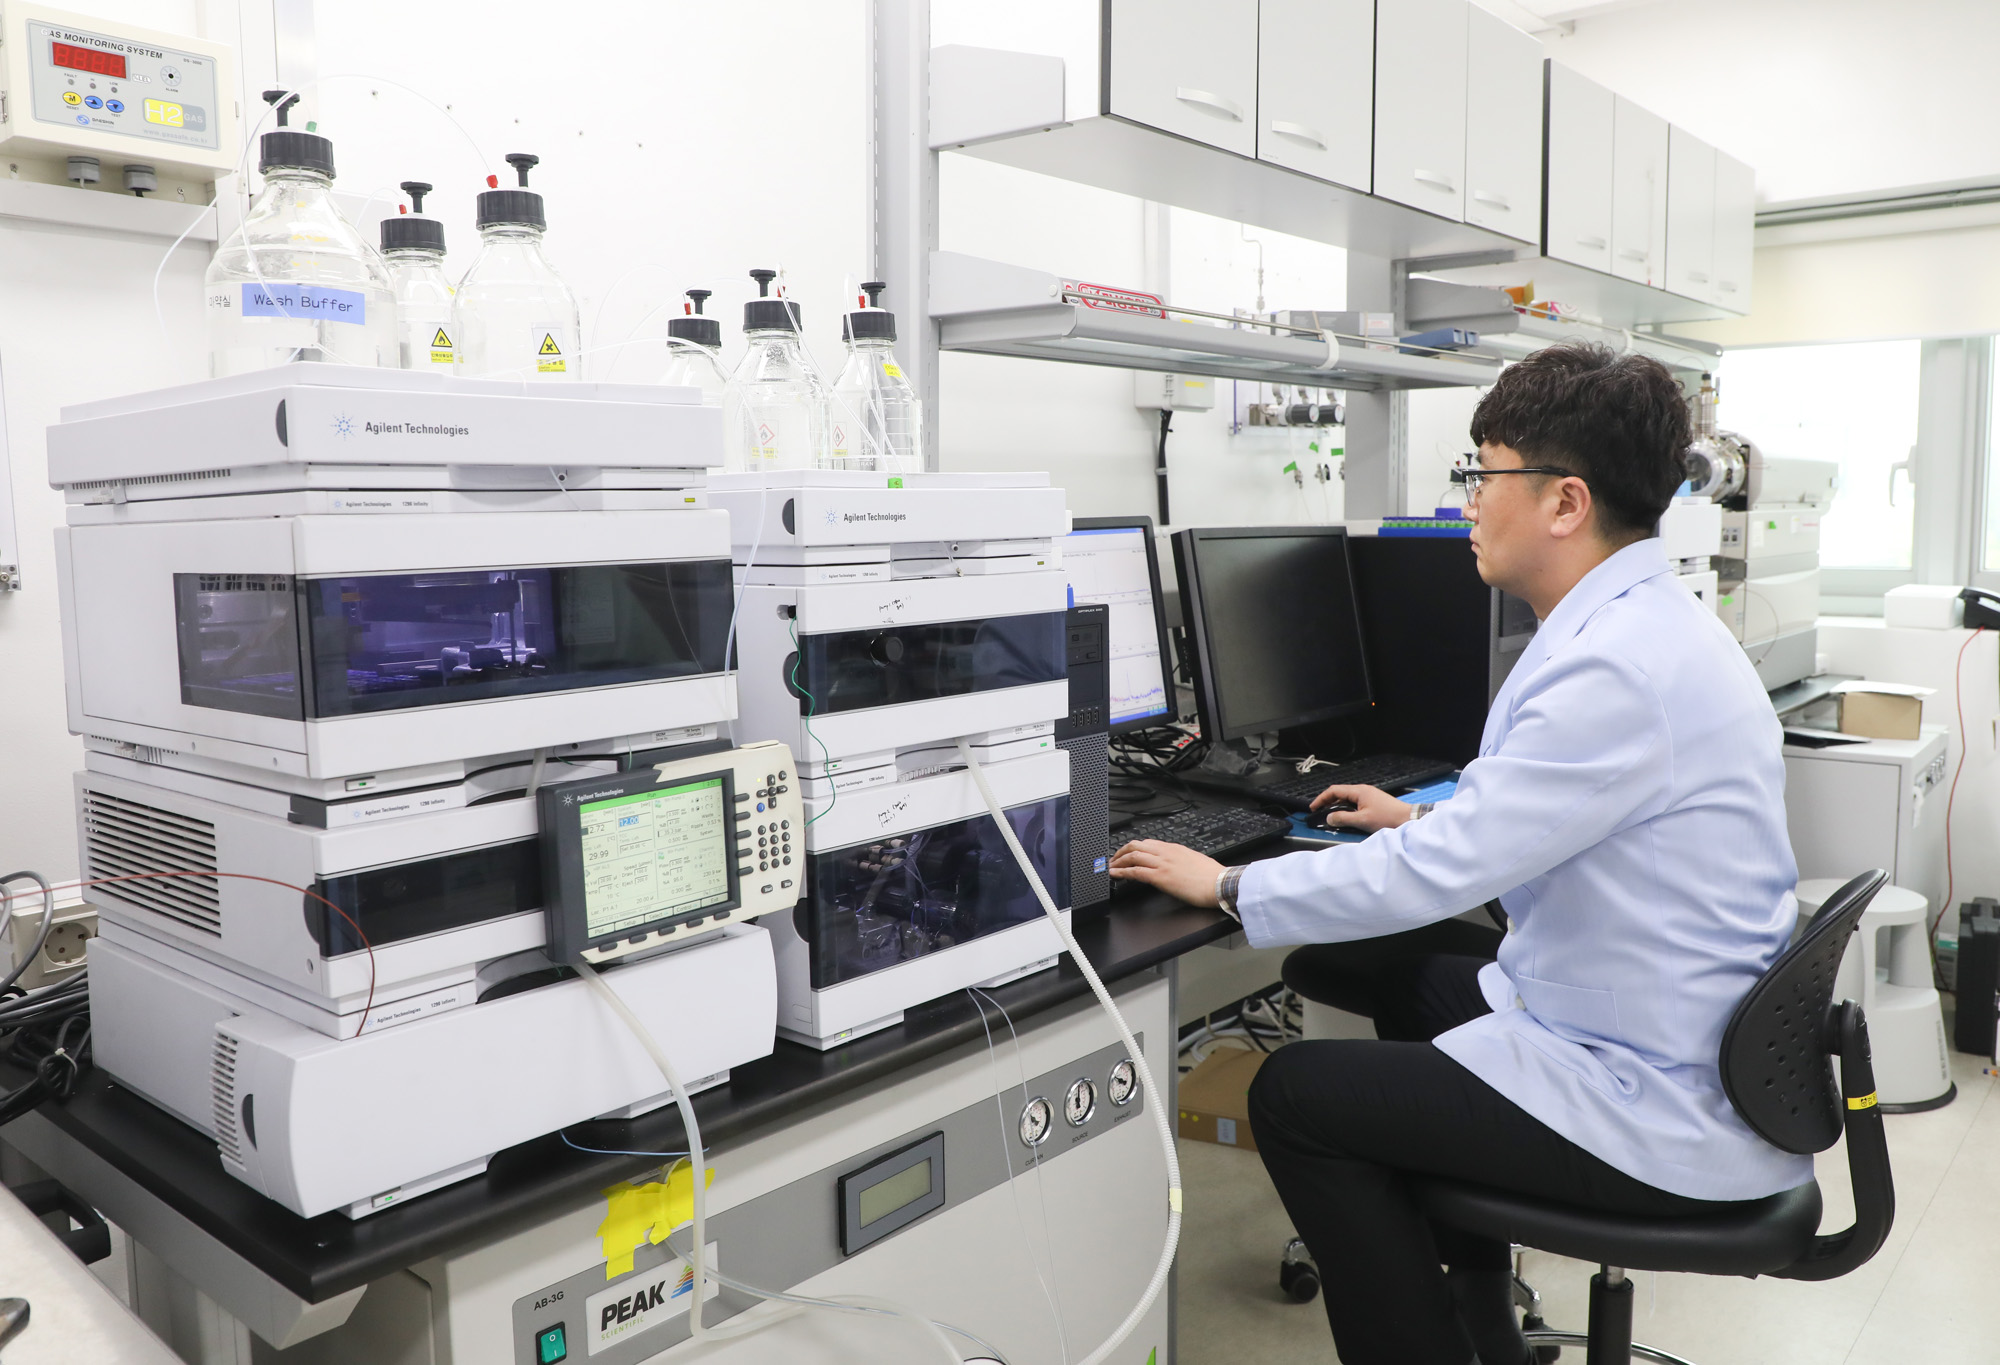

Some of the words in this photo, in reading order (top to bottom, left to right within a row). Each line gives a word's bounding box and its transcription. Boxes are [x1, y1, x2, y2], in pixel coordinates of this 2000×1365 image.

[41, 28, 61, 38] GAS
[64, 34, 124, 51] MONITORING
[126, 46, 162, 58] SYSTEM
[145, 102, 182, 125] H2
[184, 113, 203, 123] GAS
[254, 294, 292, 306] Wash
[302, 296, 352, 312] Buffer
[365, 422, 402, 435] Agilent
[404, 423, 469, 437] Technologies
[844, 513, 866, 523] Agilent
[867, 512, 906, 522] Technologies
[594, 788, 624, 798] Technologies
[620, 816, 639, 827] 12.00
[590, 825, 604, 834] 2.72
[589, 850, 608, 860] 29.99
[394, 1008, 421, 1018] Technologies
[1072, 1131, 1088, 1143] SOURCE
[534, 1290, 564, 1311] AB-3G
[601, 1280, 666, 1332] PEAK
[601, 1316, 645, 1341] SCIENTIFIC
